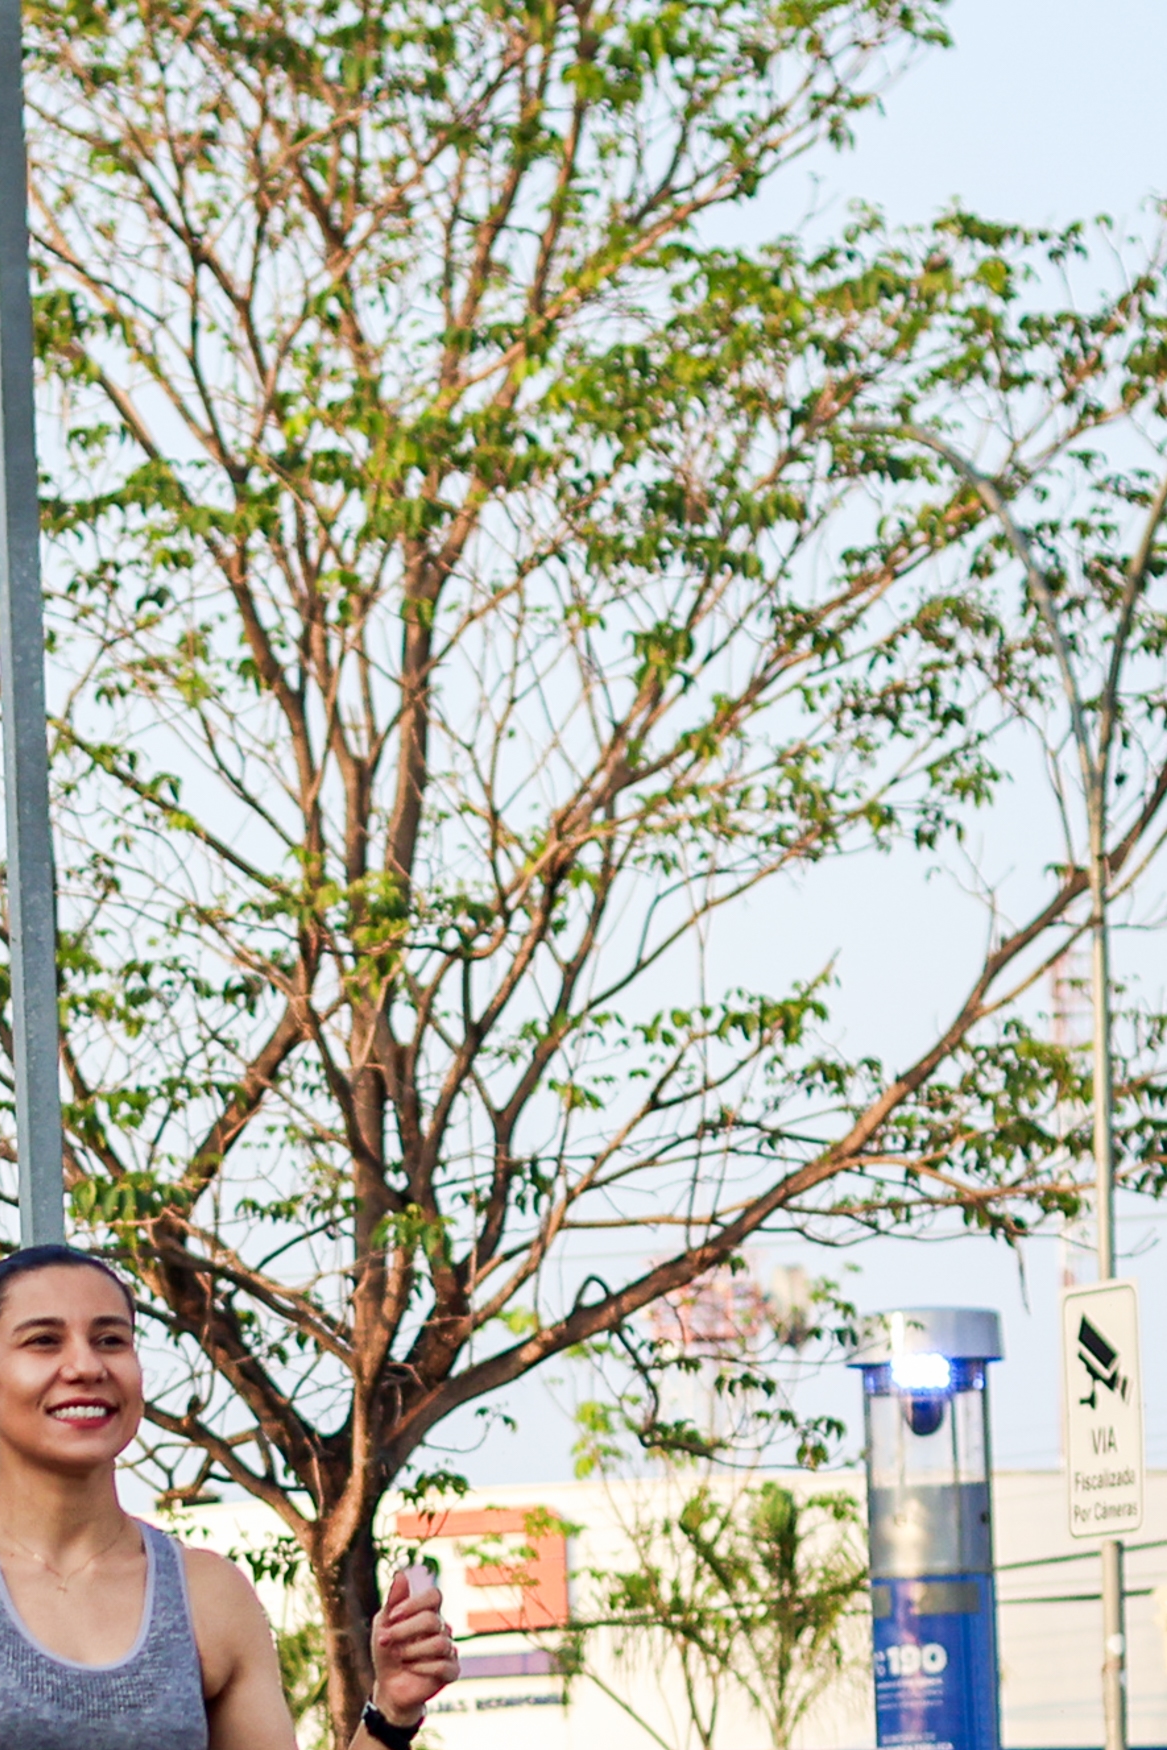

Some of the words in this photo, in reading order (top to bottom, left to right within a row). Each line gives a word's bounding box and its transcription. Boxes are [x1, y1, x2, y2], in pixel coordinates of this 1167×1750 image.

[1091, 1425, 1119, 1455] VIA
[1074, 1465, 1136, 1492] Fiscalizada
[1074, 1504, 1092, 1522] Por
[886, 1643, 948, 1676] 190
